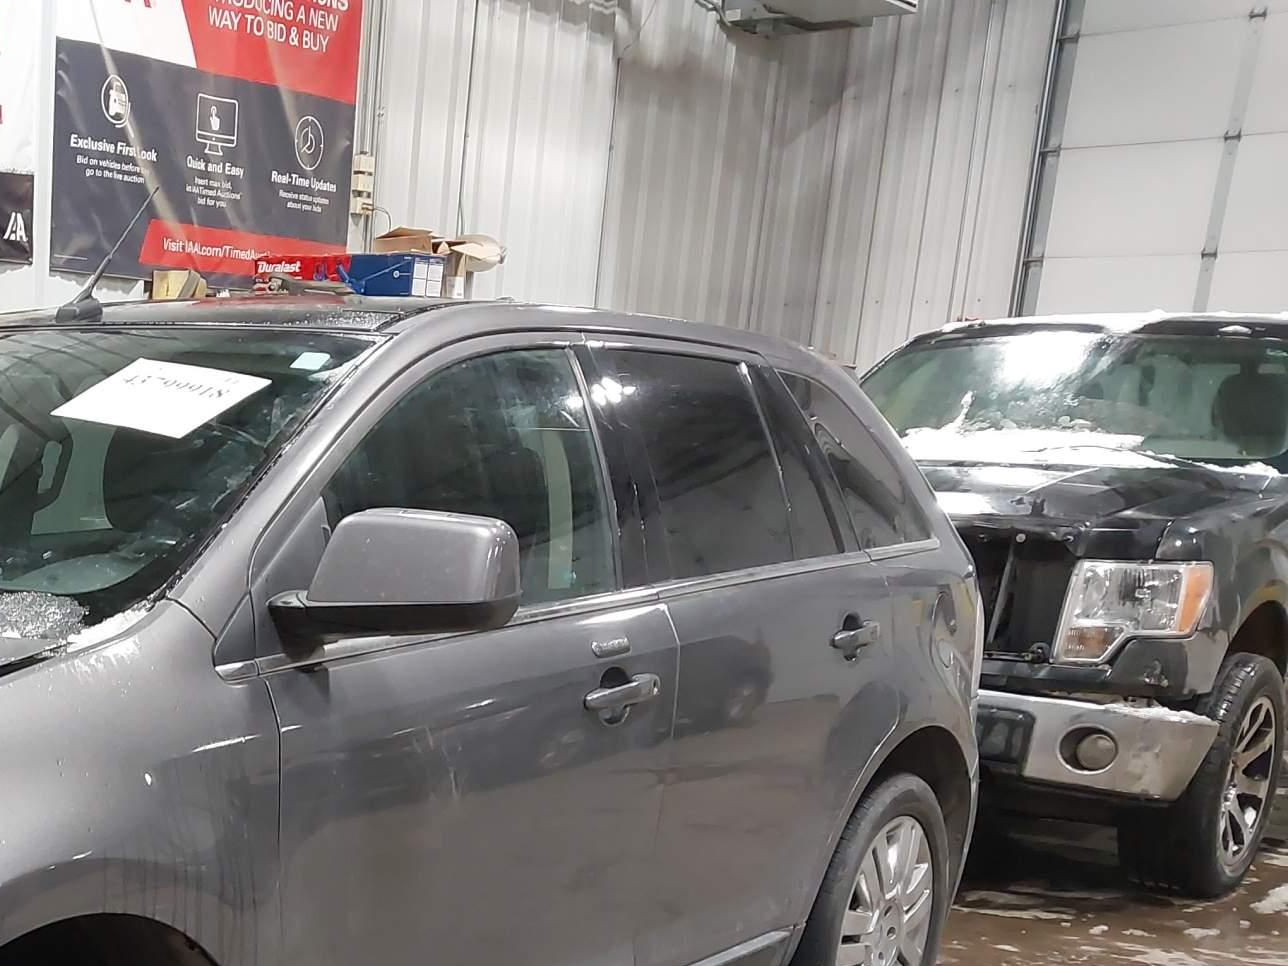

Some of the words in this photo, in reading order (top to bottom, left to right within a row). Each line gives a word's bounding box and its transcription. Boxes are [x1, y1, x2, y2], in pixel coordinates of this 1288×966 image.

[208, 5, 242, 31] WAY
[244, 14, 264, 36] TO
[266, 20, 287, 42] BID
[289, 26, 299, 47] &
[302, 29, 330, 53] BUY
[296, 5, 306, 25] A
[309, 8, 339, 32] NEW
[70, 133, 116, 154] Exclusive
[76, 154, 89, 164] Bid
[89, 158, 98, 166] on
[99, 159, 121, 170] vehicles
[186, 155, 206, 171] Quick
[207, 162, 223, 173] and
[225, 162, 244, 180] Easy
[85, 168, 95, 177] go
[95, 168, 103, 177] to
[103, 169, 113, 178] the
[123, 174, 145, 184] auction
[271, 170, 310, 188] Real-Time
[311, 177, 337, 193] Updates
[163, 237, 185, 252] Visit
[256, 260, 301, 273] Duralast
